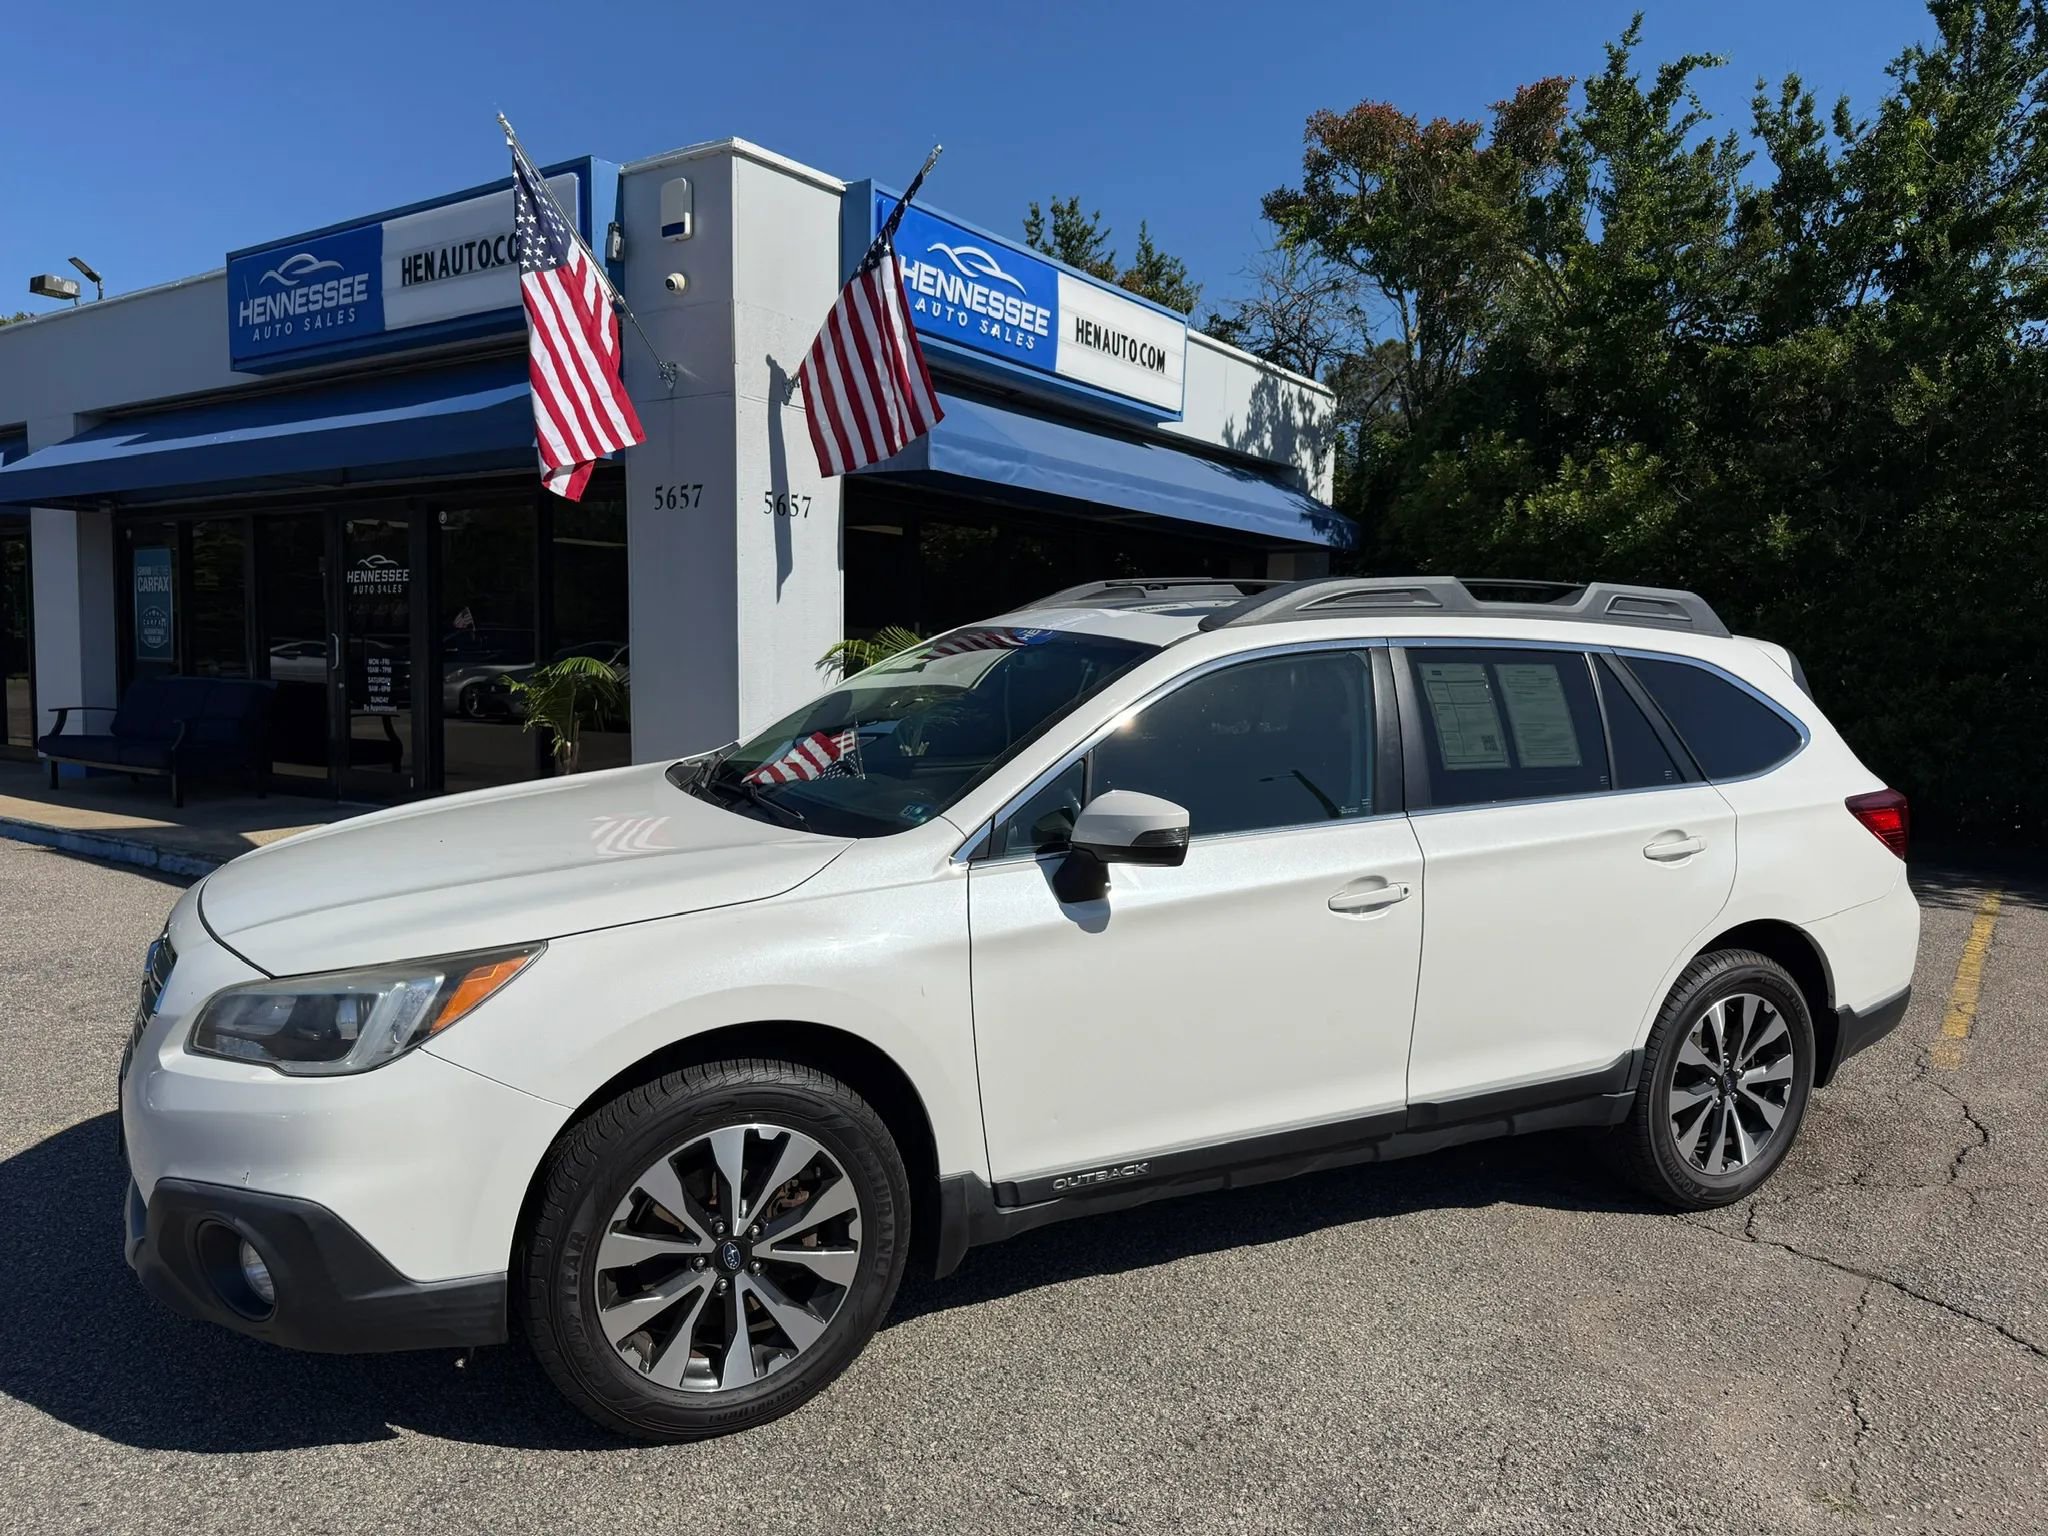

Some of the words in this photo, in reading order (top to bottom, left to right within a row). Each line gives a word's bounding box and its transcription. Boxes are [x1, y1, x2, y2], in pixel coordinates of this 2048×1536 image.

[239, 273, 369, 327] HENNESSEE
[899, 254, 1051, 337] HENNESSEE
[252, 322, 293, 342] AUTO
[304, 307, 356, 332] SALES
[914, 297, 968, 327] AUTO
[979, 319, 1036, 349] SALES
[654, 484, 703, 511] 5657
[763, 491, 812, 519] 5657
[137, 576, 169, 592] CARFAX
[346, 569, 410, 583] HENNESSEE
[353, 585, 375, 595] AUTO
[377, 584, 402, 595] SALES
[370, 696, 389, 704] SUNDAY
[1052, 1162, 1149, 1190] OUTBACK
